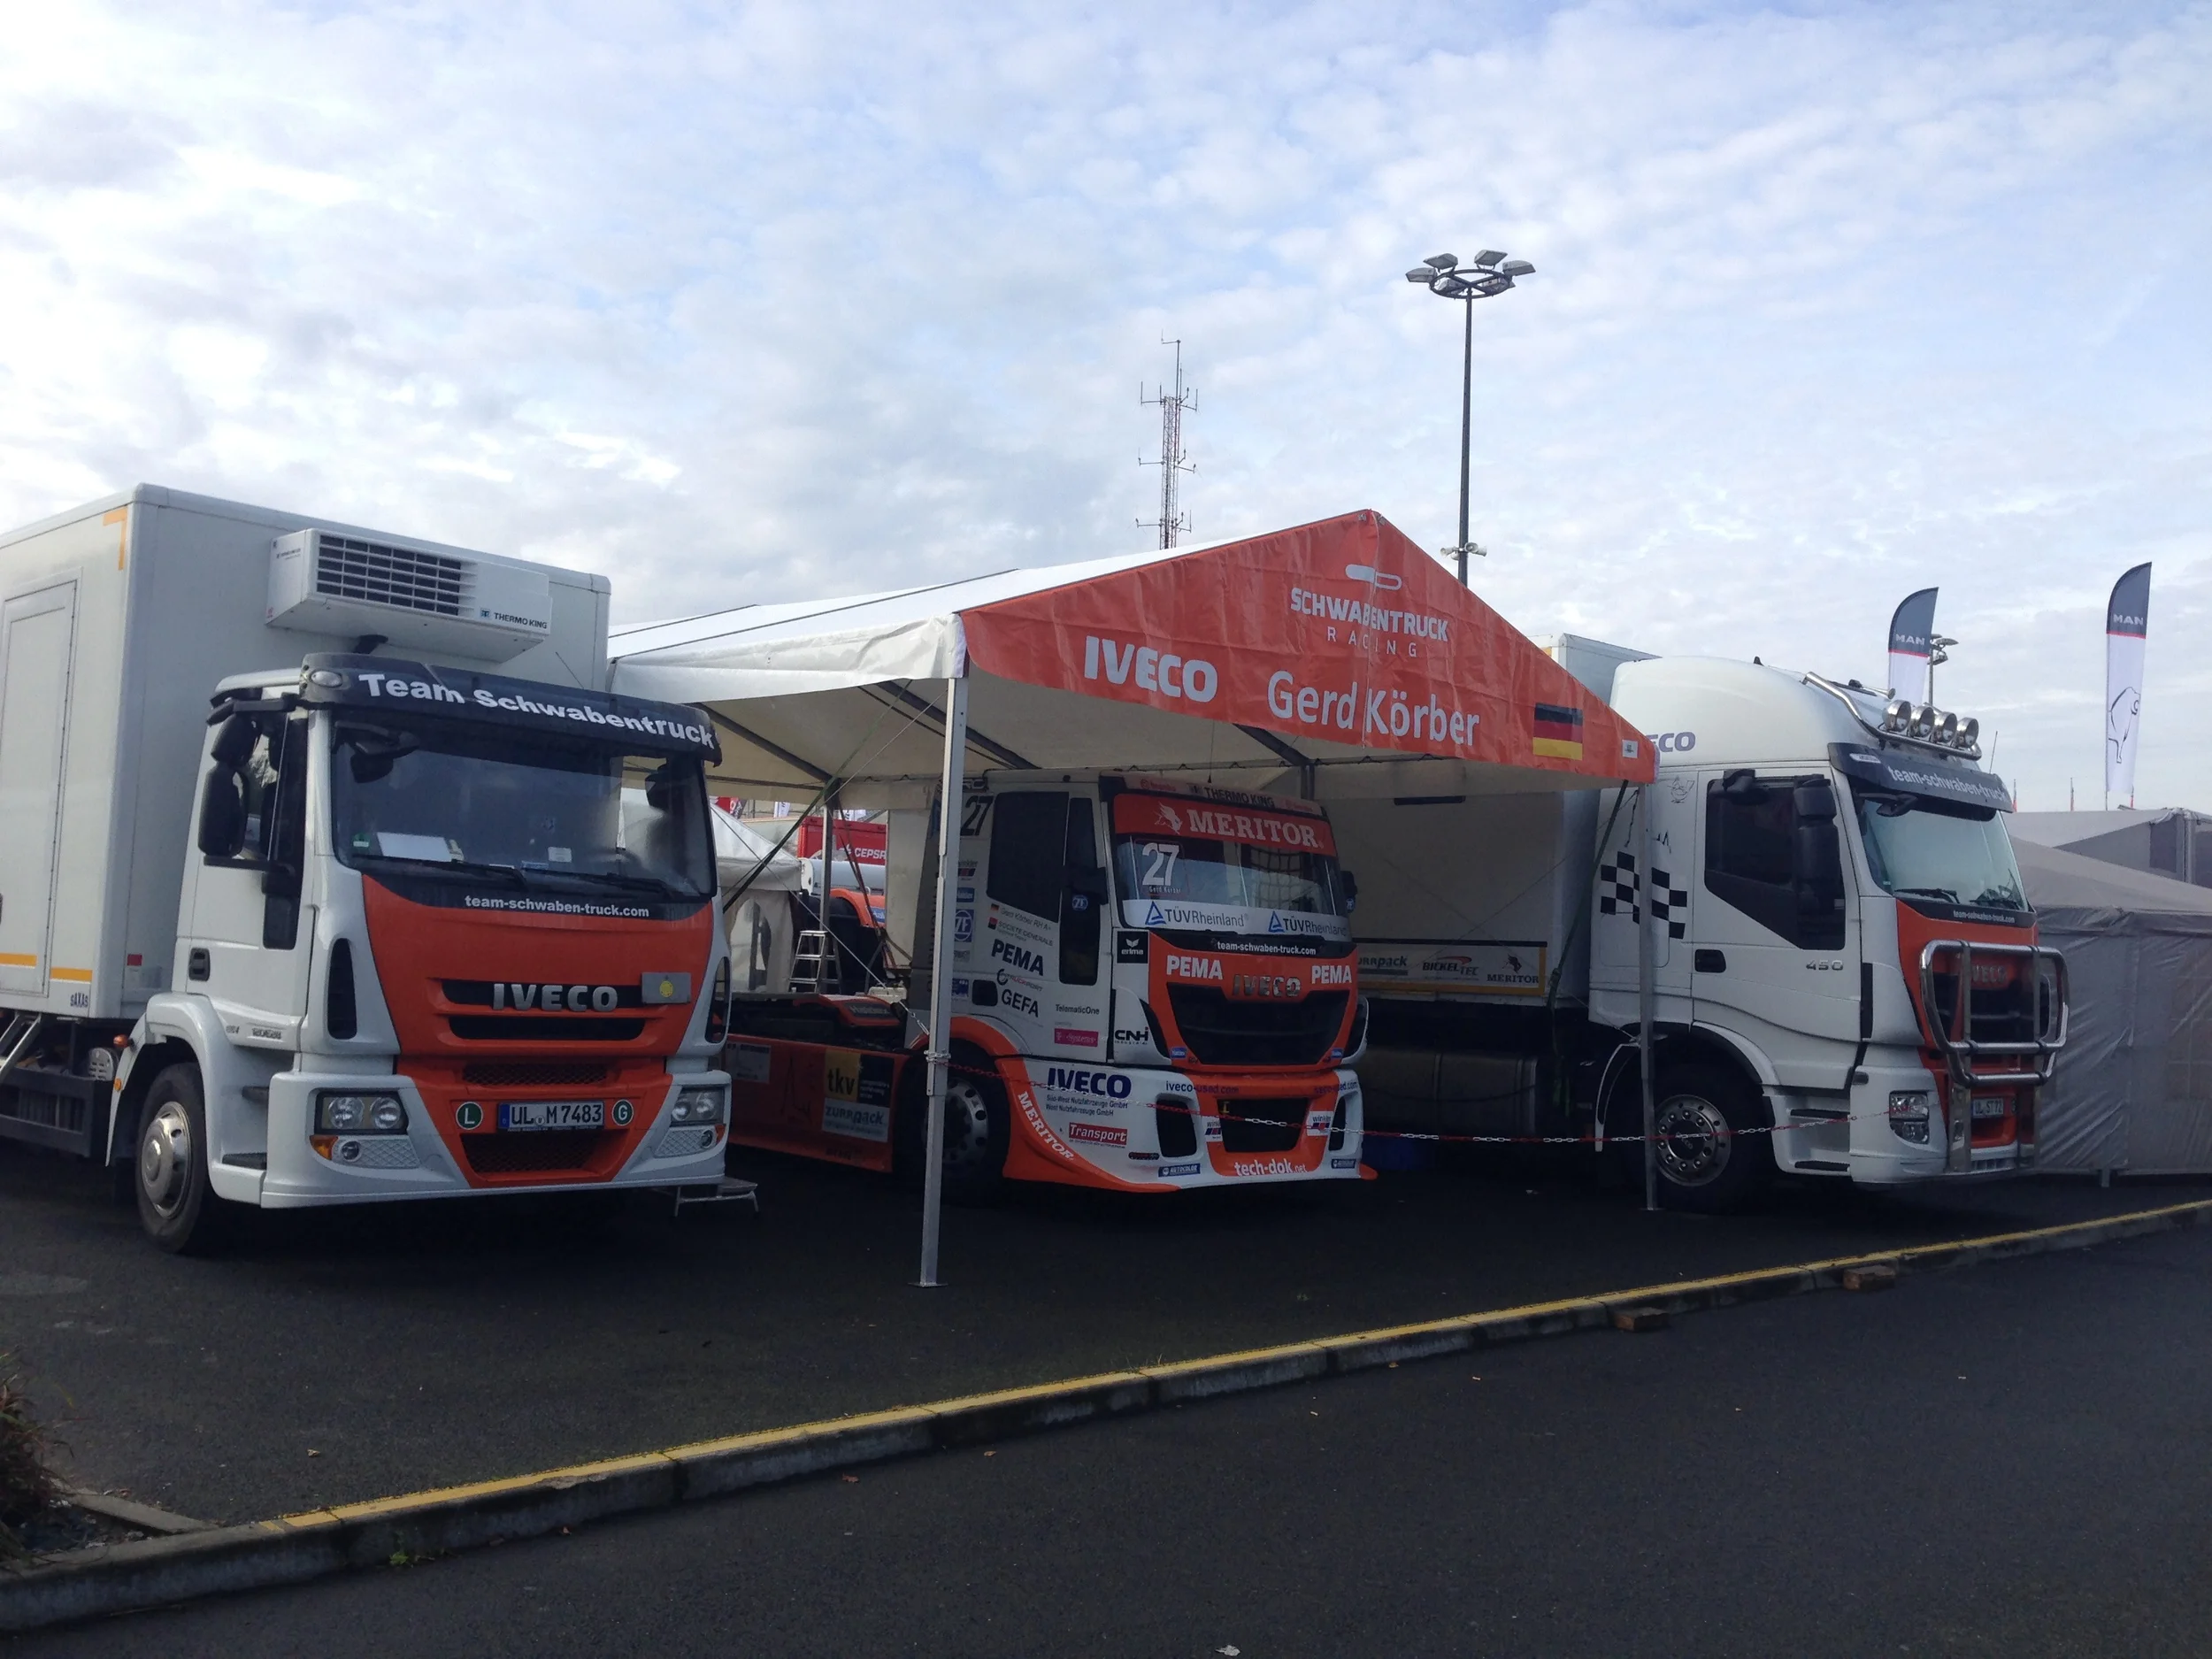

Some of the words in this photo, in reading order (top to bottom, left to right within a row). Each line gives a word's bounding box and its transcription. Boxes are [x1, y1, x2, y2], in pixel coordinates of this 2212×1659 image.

[494, 612, 527, 625] THERMO
[529, 618, 548, 629] KING
[1291, 587, 1448, 641] SCHWABENTRUCK
[2113, 613, 2144, 626] MAN
[1327, 626, 1418, 658] RACING
[1895, 633, 1925, 646] MAN
[1084, 635, 1218, 703] IVECO
[358, 673, 465, 704] Team
[472, 688, 716, 749] Schwabentruck
[1267, 670, 1358, 731] Gerd
[1366, 688, 1480, 746] Körber
[1204, 787, 1250, 804] THERMO
[1250, 795, 1275, 808] KING
[960, 795, 994, 836] 27
[1186, 809, 1320, 849] MERITOR
[1142, 842, 1179, 887] 27
[465, 895, 649, 918] team-schwaben-truck.com
[991, 939, 1044, 976] PEMA
[1121, 947, 1144, 956] erima
[1217, 940, 1317, 956] team-schwaben-truck.com
[1166, 955, 1224, 980] PEMA
[1311, 964, 1353, 985] PEMA
[1806, 960, 1844, 971] 450
[1232, 975, 1302, 997] IVECO
[1486, 973, 1540, 984] MERITOR
[492, 983, 618, 1012] IVECO
[1002, 989, 1040, 1018] GEFA
[1056, 1003, 1100, 1015] TelematicOne
[827, 1068, 856, 1095] tkv
[1047, 1068, 1132, 1099] IVECO
[1165, 1080, 1240, 1094] iveco-used.com
[511, 1106, 534, 1125] UL
[547, 1105, 557, 1124] M
[561, 1104, 602, 1123] 7483
[618, 1105, 628, 1121] G
[1110, 1100, 1129, 1109] GmbH
[464, 1107, 476, 1125] L
[1018, 1090, 1074, 1160] MERITOR
[1070, 1123, 1127, 1142] Transport
